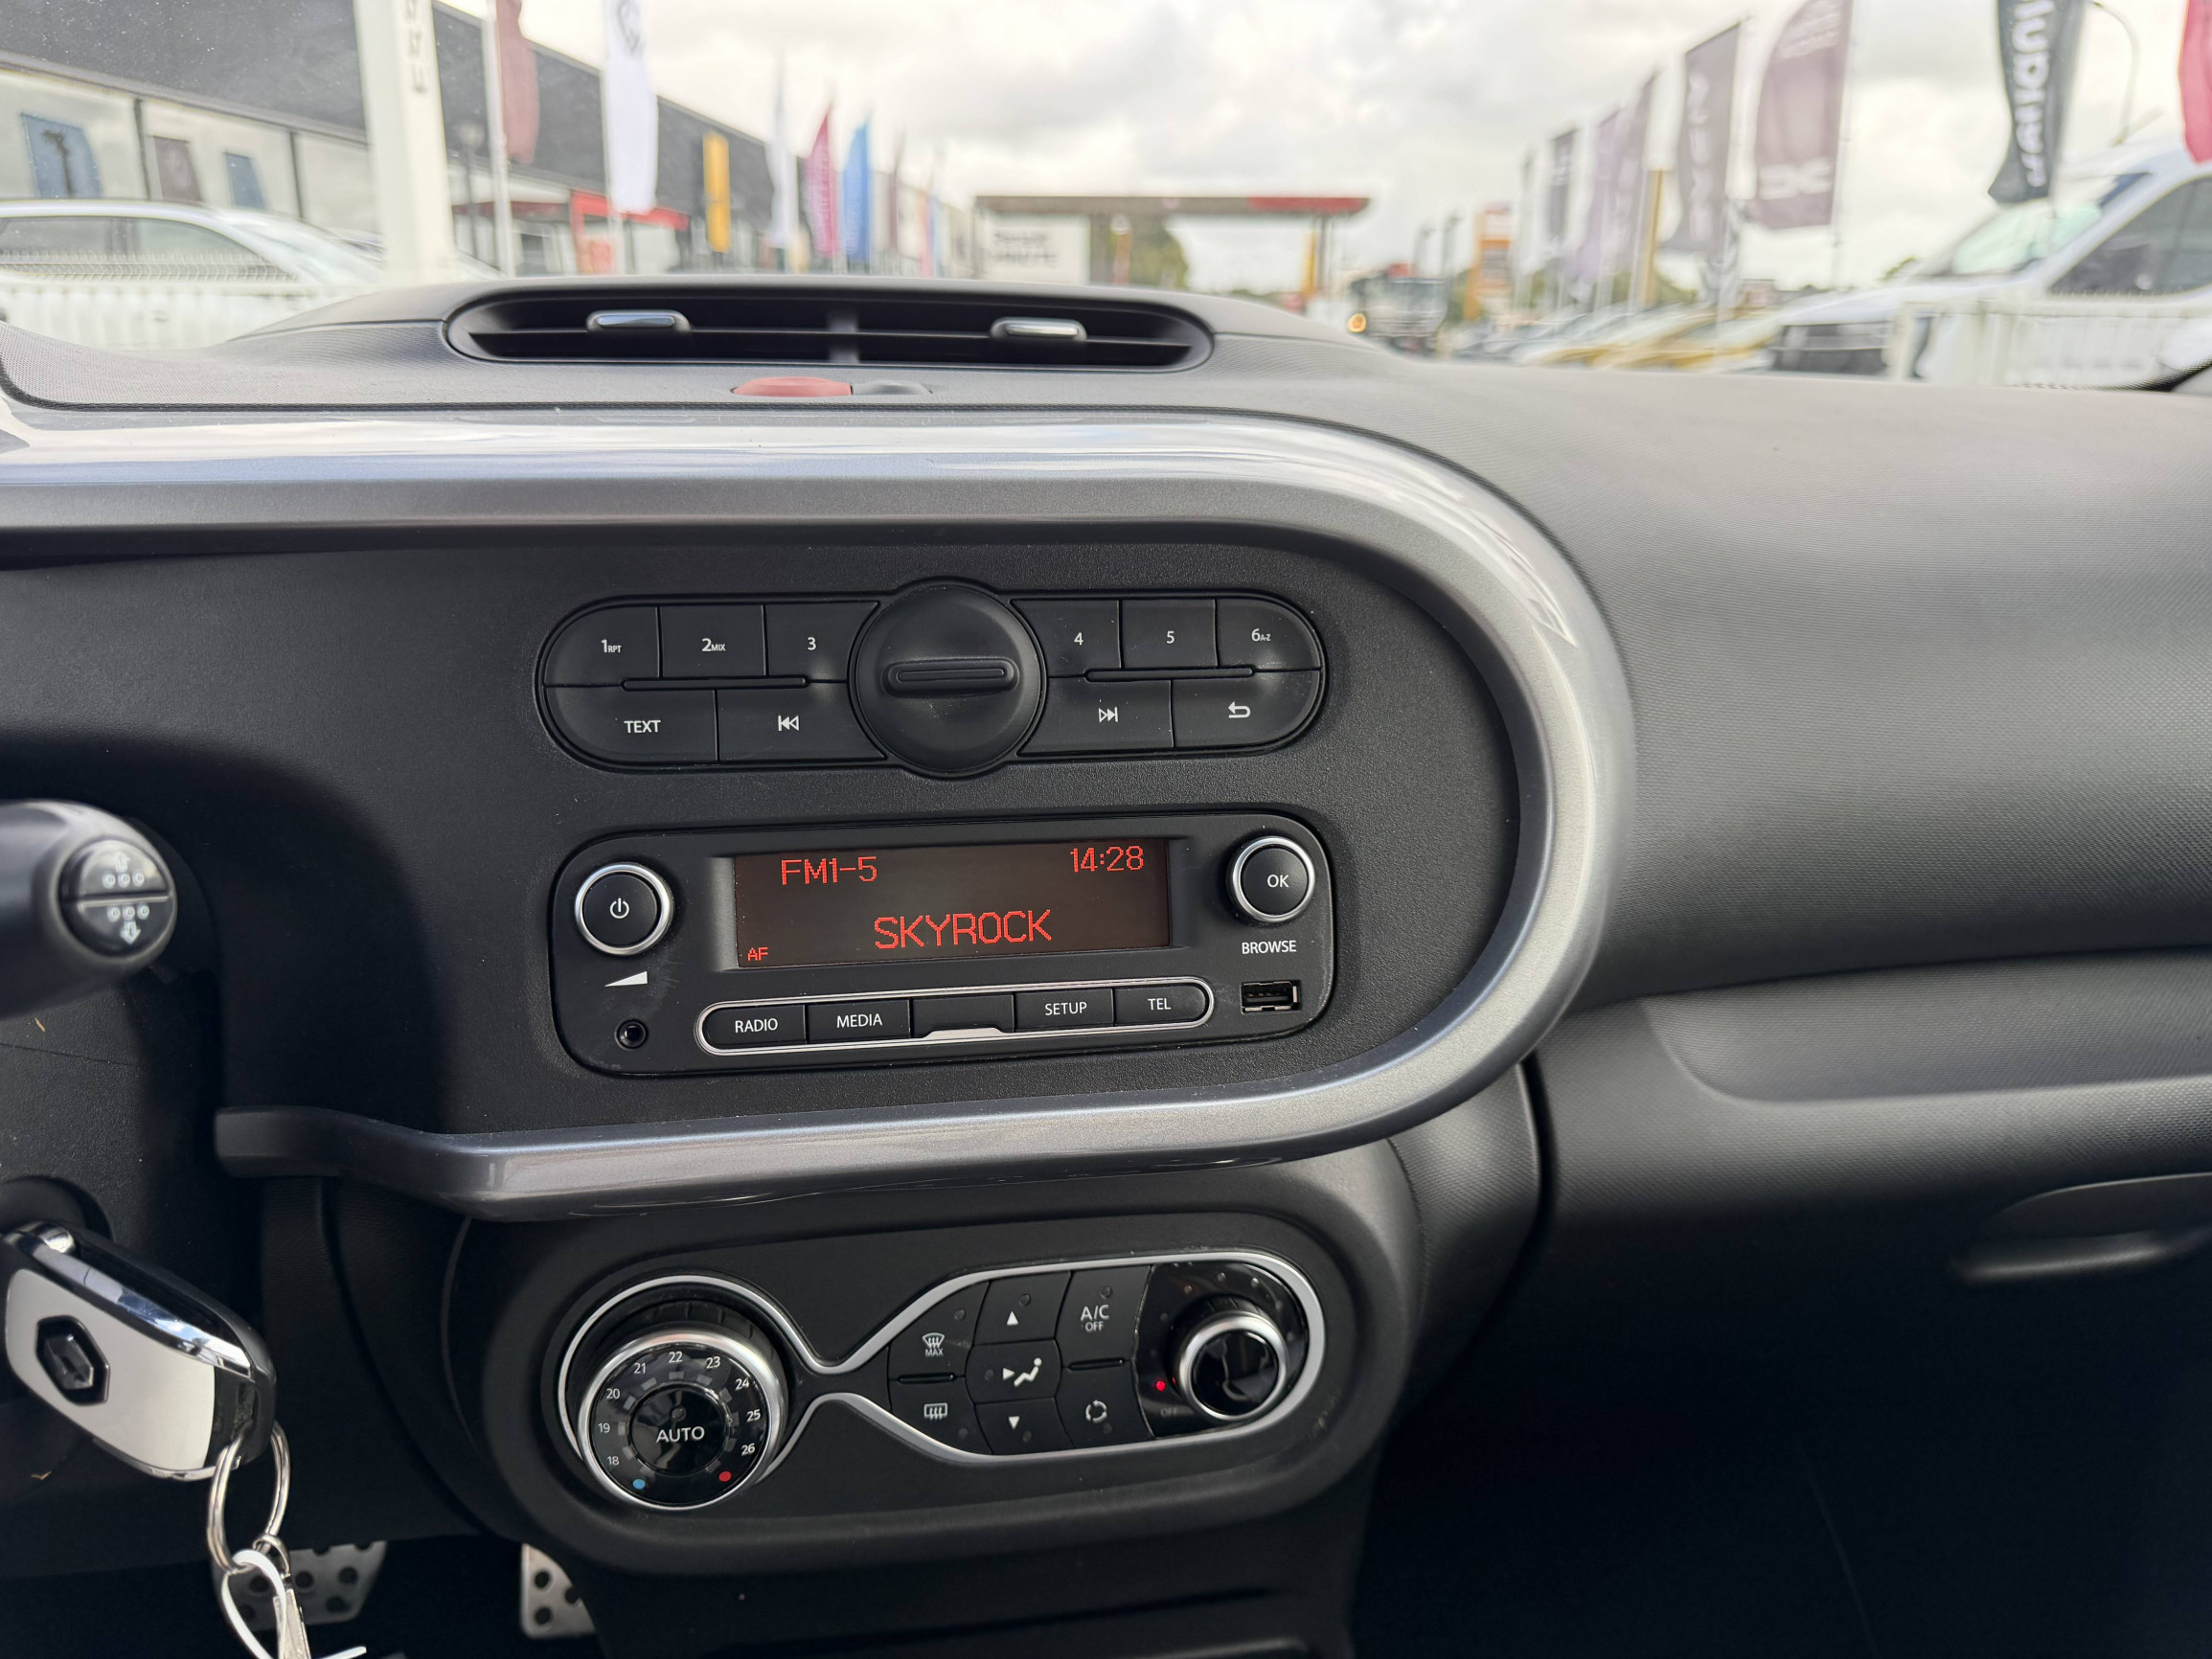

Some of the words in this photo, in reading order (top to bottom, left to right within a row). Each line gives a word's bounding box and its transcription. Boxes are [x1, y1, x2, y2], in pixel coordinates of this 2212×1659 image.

[808, 636, 817, 651] 3
[1074, 632, 1084, 646] 4
[1166, 630, 1175, 645] 5
[623, 719, 662, 734] TEXT
[1069, 845, 1145, 874] 14:28
[781, 855, 878, 886] FM1-5
[1266, 874, 1289, 888] OK
[874, 909, 1052, 949] SKYROCK
[747, 946, 769, 962] AF
[1242, 940, 1297, 955] BROWSE
[1044, 1001, 1087, 1016] SETUP
[1147, 997, 1172, 1011] TEL
[735, 1017, 779, 1034] RADIO
[836, 1012, 883, 1029] MEDIA
[1081, 1305, 1109, 1320] A/C
[1085, 1321, 1105, 1331] OFF
[668, 1351, 683, 1364] 22
[924, 1346, 945, 1357] MAX
[633, 1362, 647, 1375] 21
[705, 1355, 721, 1370] 23
[735, 1377, 750, 1391] 24
[605, 1388, 621, 1399] 20
[746, 1408, 762, 1422] 25
[598, 1422, 611, 1434] 19
[655, 1425, 705, 1443] AUTO
[741, 1443, 756, 1456] 26
[606, 1455, 620, 1466] 18
